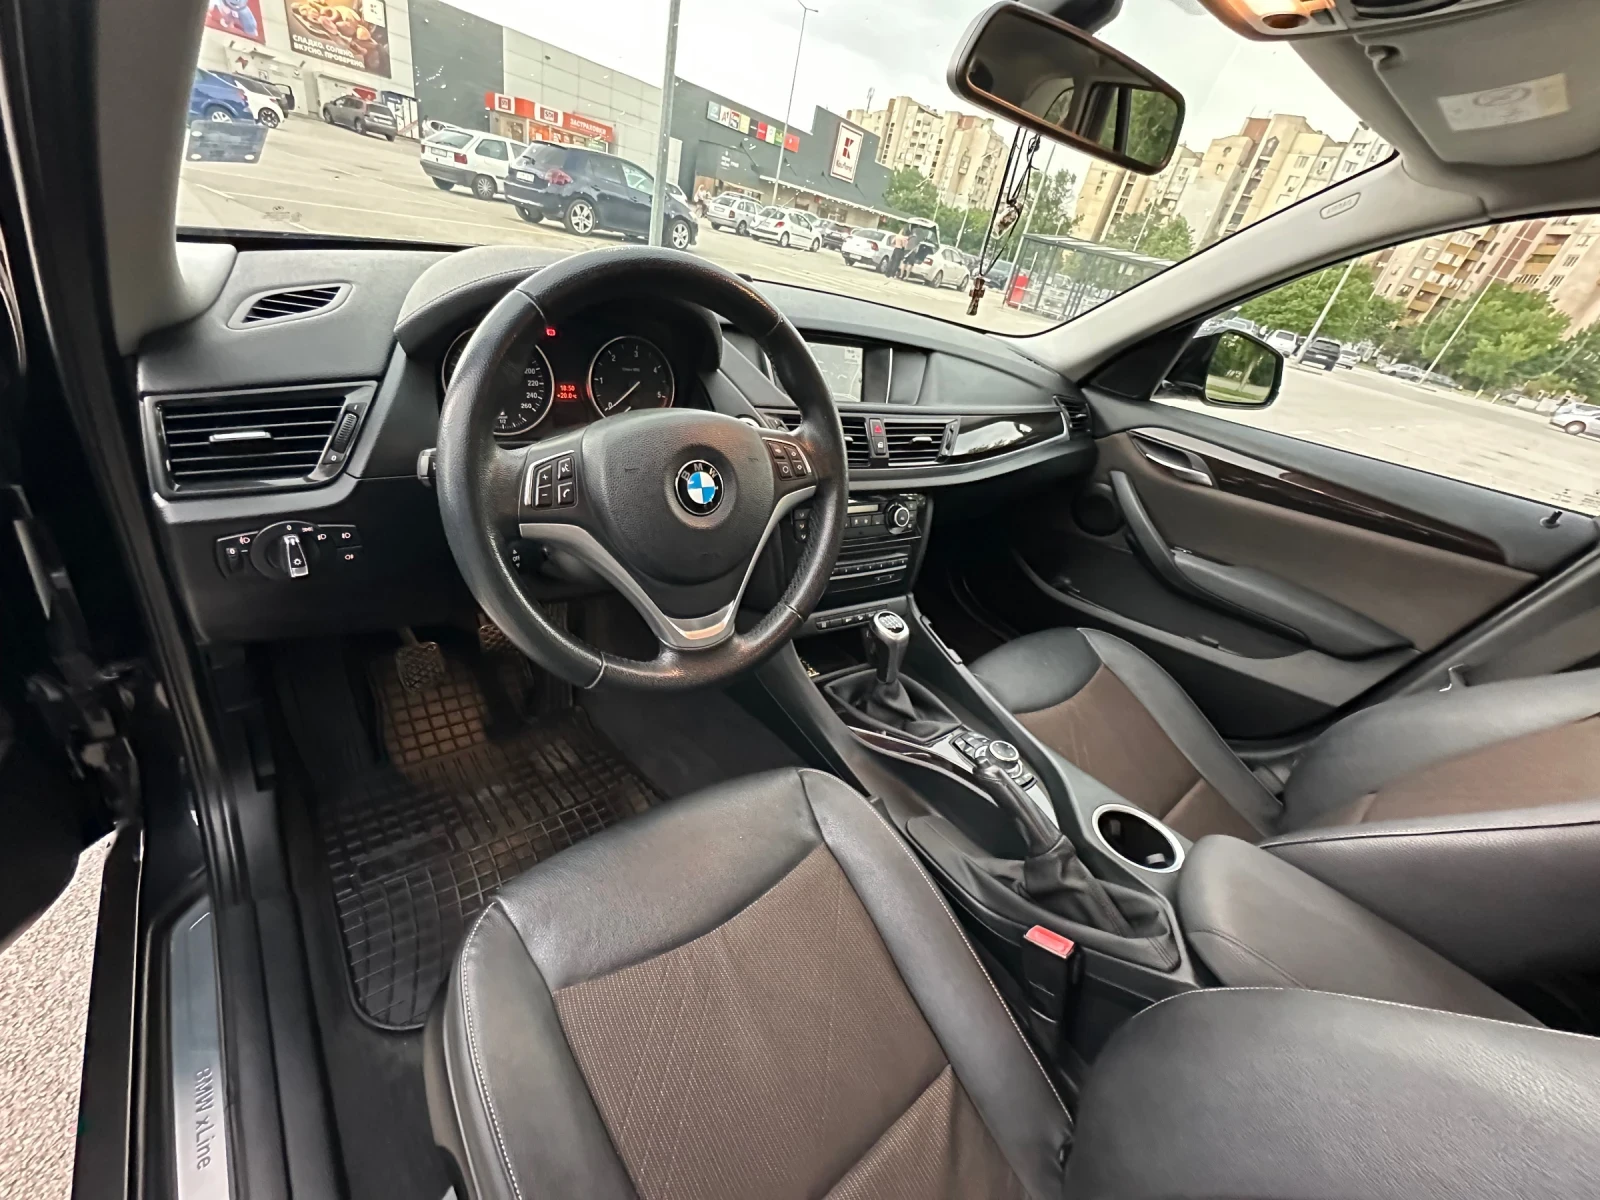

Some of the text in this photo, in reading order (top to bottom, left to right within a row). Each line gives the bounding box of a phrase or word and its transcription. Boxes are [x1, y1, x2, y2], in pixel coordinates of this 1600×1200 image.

[292, 34, 325, 50] СЛАДКО.
[293, 41, 324, 56] ВКУСНО.
[569, 118, 607, 135] ЗАСТРАХОВКИ
[611, 354, 616, 362] 2
[633, 350, 639, 358] 3
[653, 366, 658, 374] 4
[680, 462, 718, 481] BMW
[194, 1067, 215, 1170] BMW xLine
